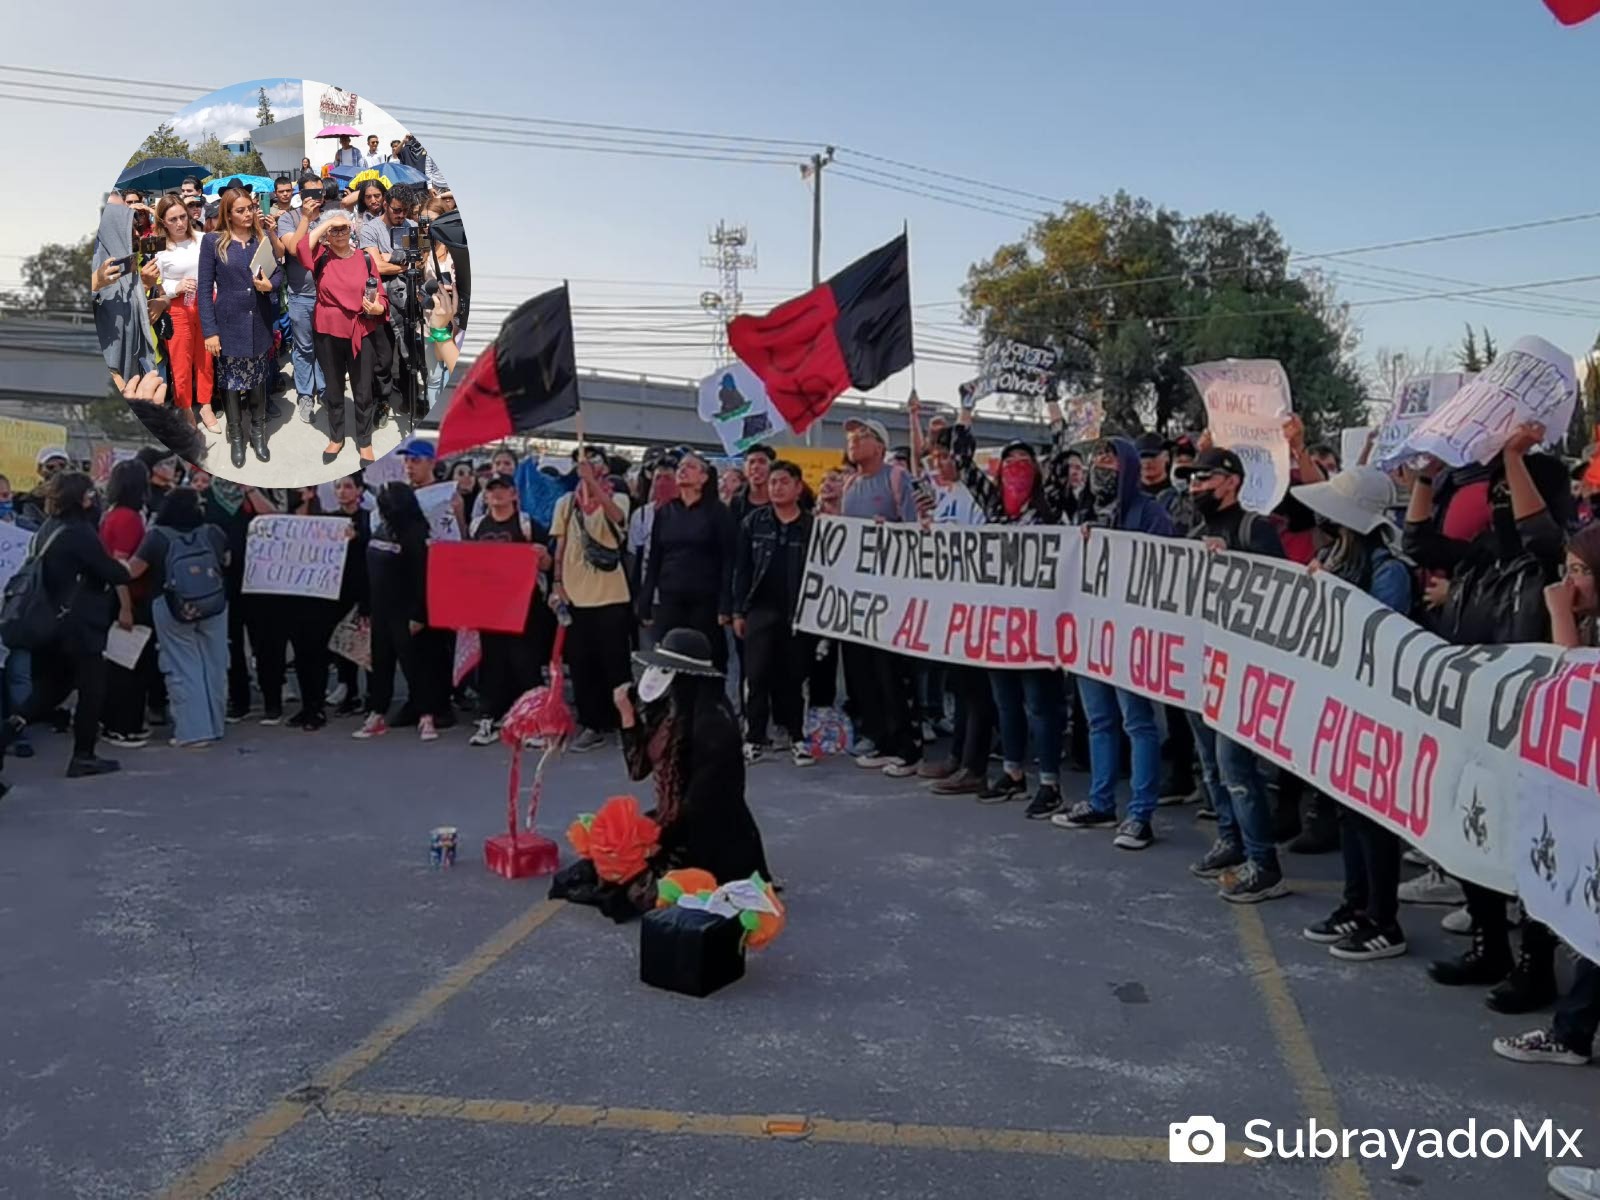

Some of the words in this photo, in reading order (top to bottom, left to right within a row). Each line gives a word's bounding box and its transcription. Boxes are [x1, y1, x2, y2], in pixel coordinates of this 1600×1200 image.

[797, 572, 888, 642] PODER
[892, 597, 931, 653] AL
[944, 602, 1079, 666] PUEBLO
[1087, 617, 1116, 677] LO
[1129, 625, 1186, 700] QUE
[1236, 664, 1296, 762] DEL
[1310, 696, 1440, 838] PUEBLO
[809, 518, 848, 567] NO
[855, 525, 1061, 590] ENTREGAREMOS
[1081, 536, 1110, 598] LA
[1125, 539, 1352, 670] UNIVERSIDAD
[1355, 607, 1392, 688] A
[1391, 628, 1508, 729] LOS
